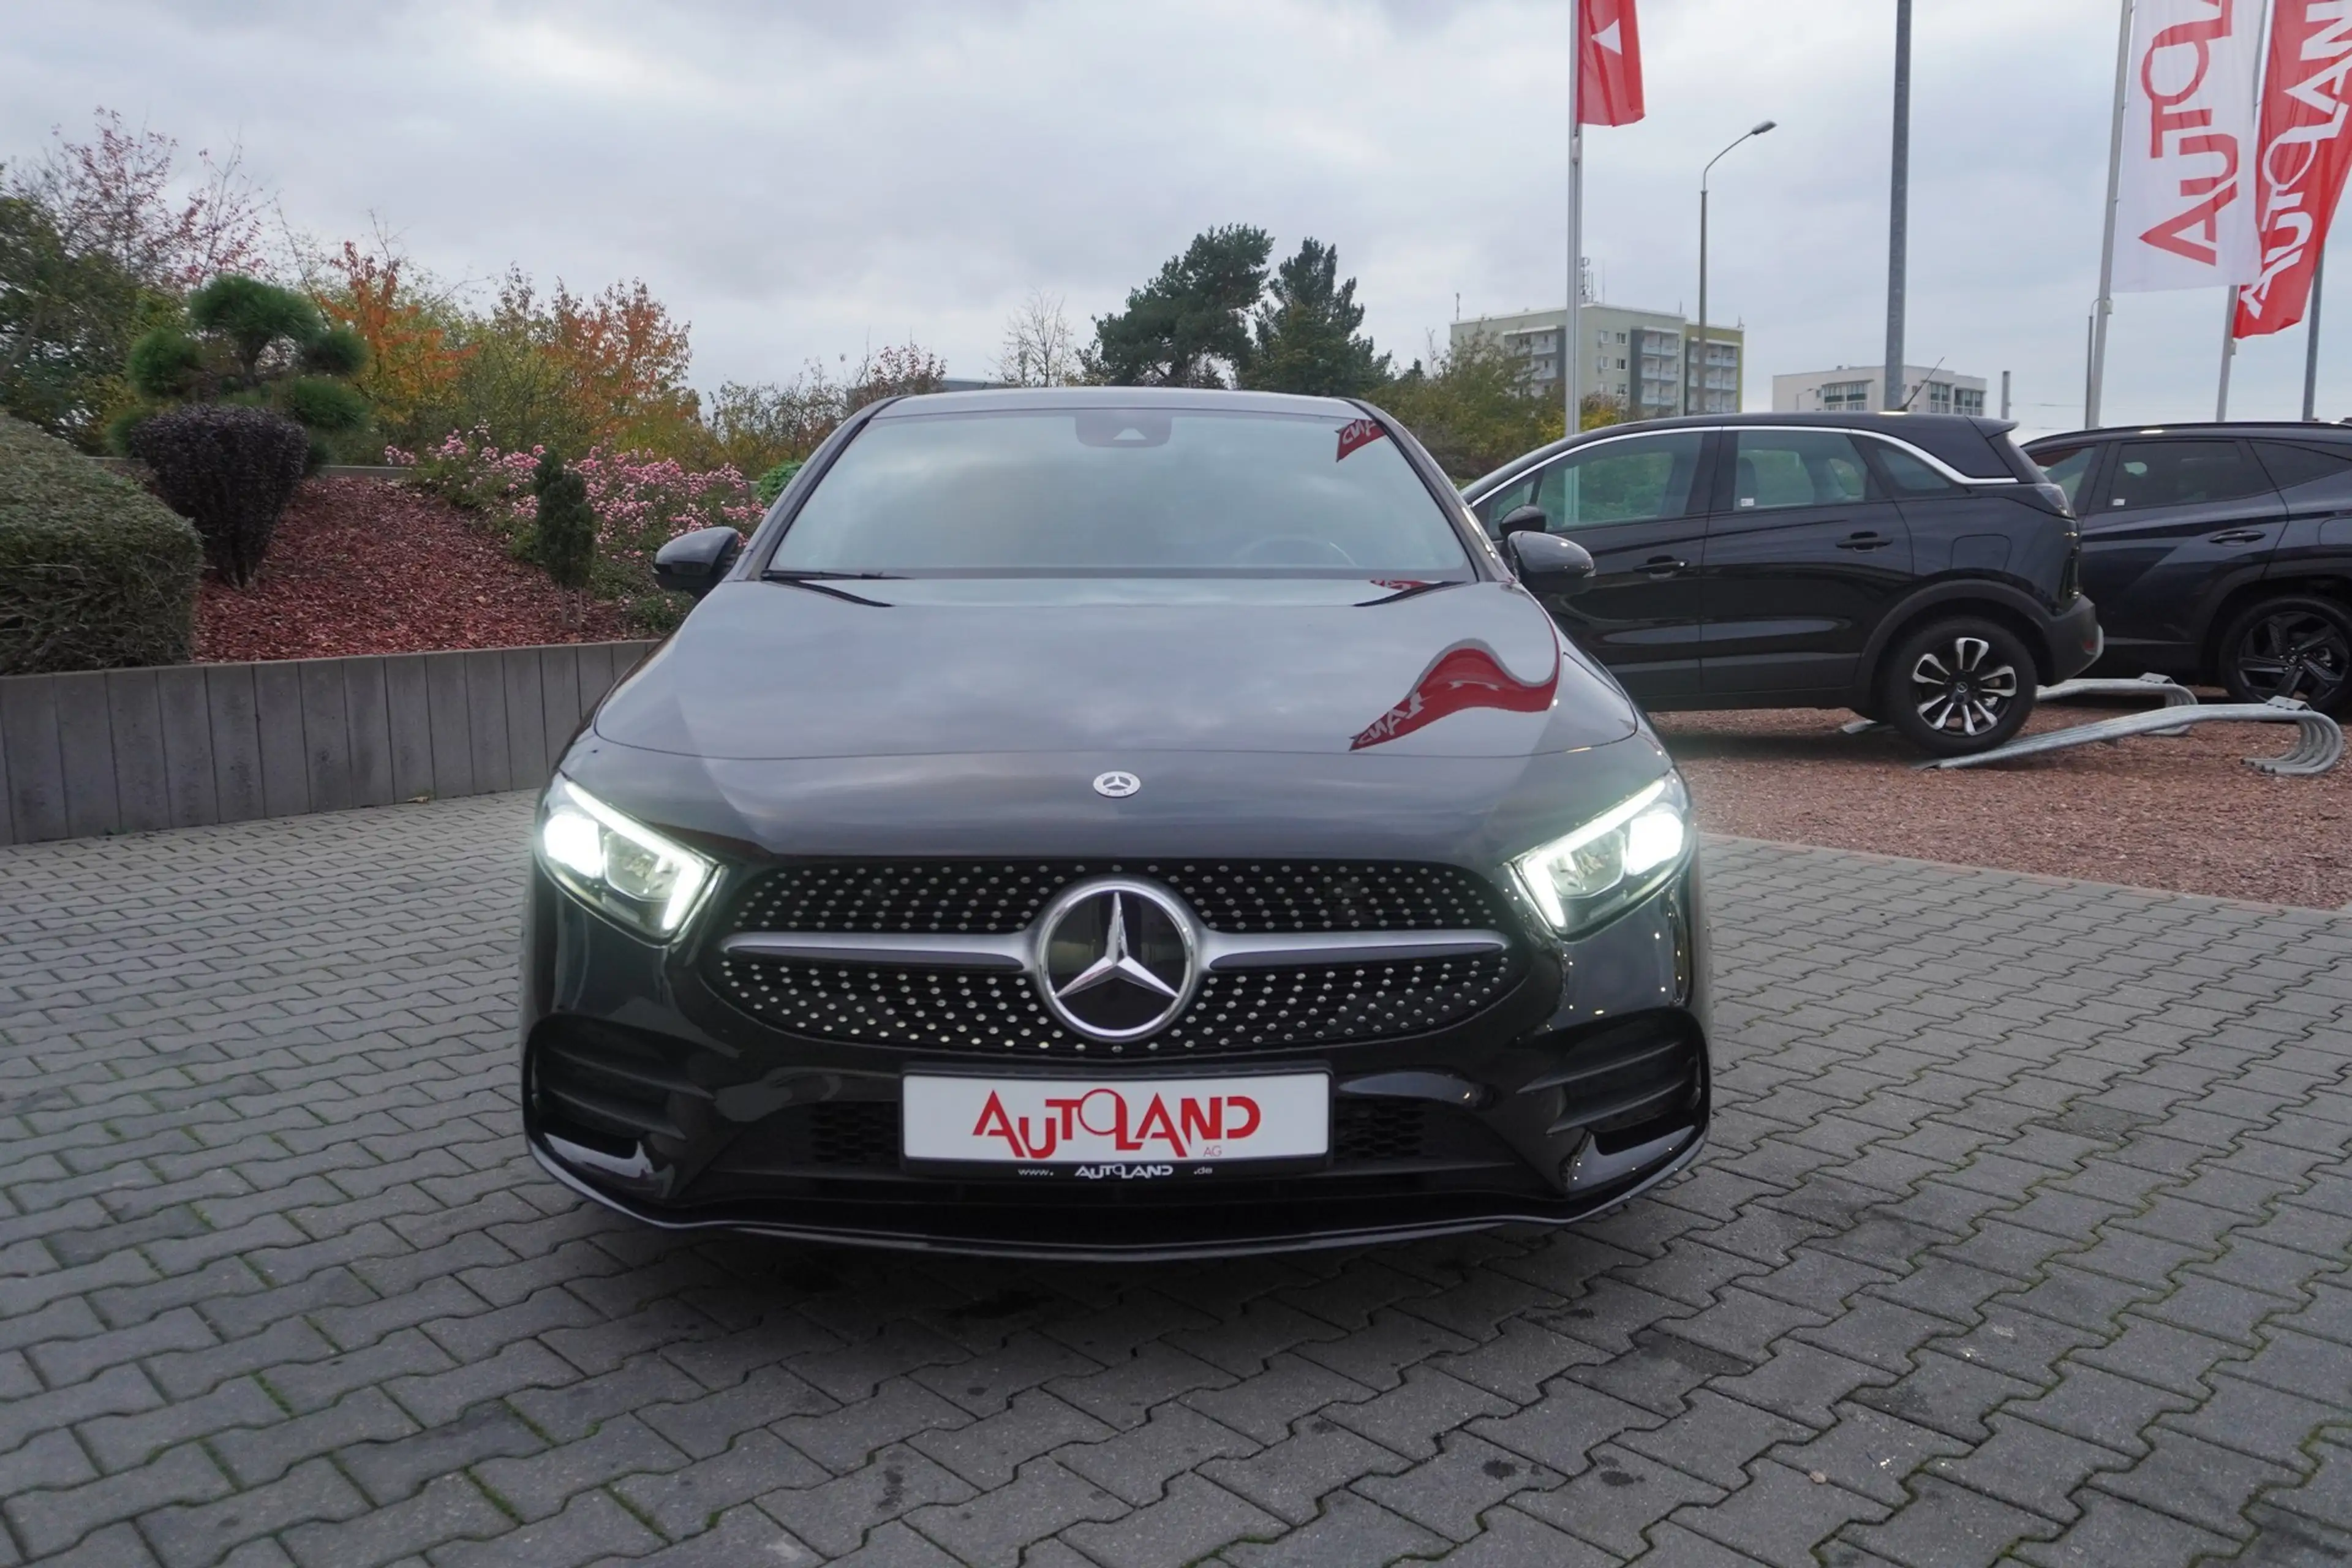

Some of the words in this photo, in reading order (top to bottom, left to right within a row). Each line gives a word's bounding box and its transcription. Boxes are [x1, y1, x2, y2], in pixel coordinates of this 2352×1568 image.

[2139, 0, 2237, 266] AUTOL
[972, 1088, 1261, 1159] AUTOLAND
[1075, 1163, 1174, 1179] AUTOLAND
[1202, 1145, 1223, 1157] AG
